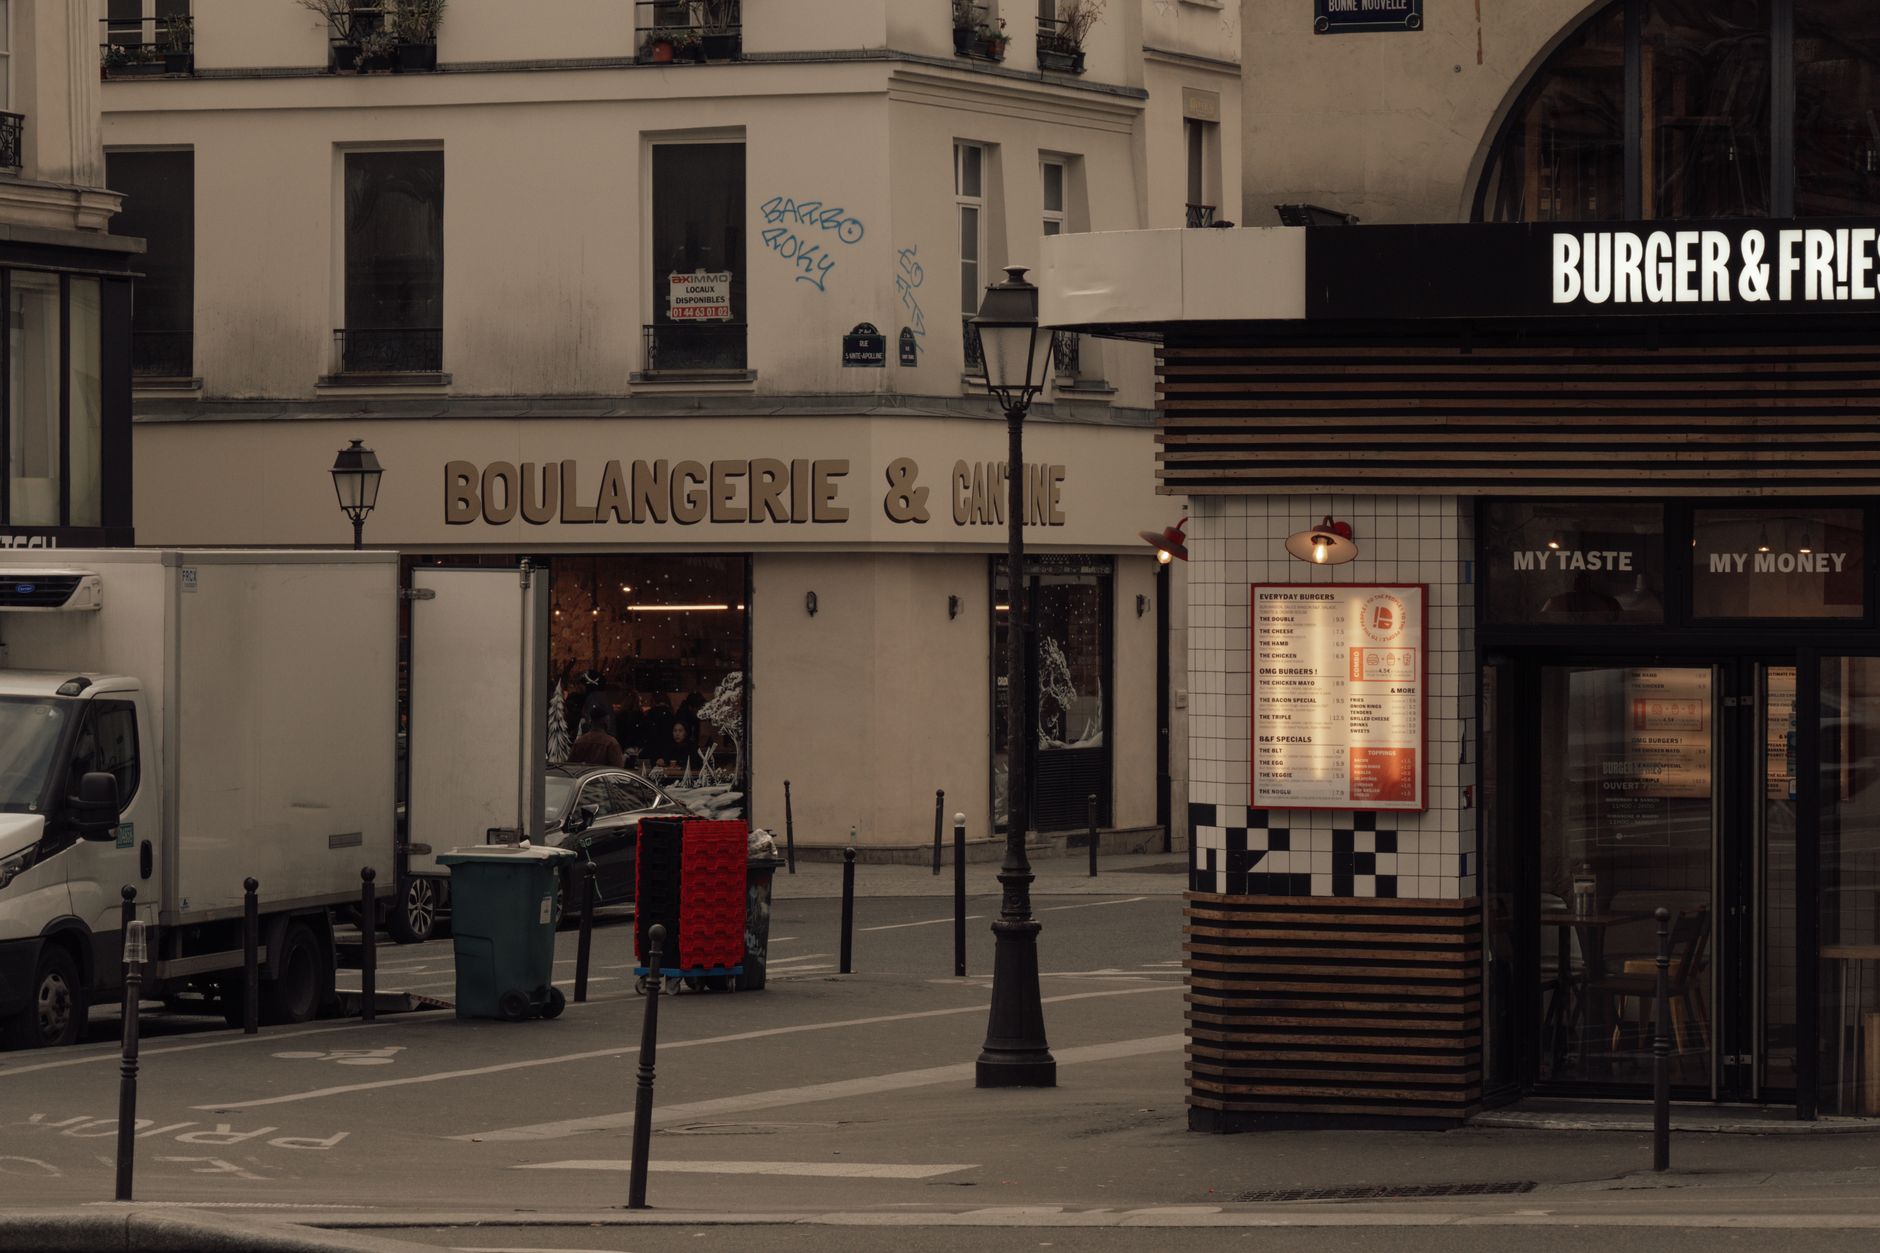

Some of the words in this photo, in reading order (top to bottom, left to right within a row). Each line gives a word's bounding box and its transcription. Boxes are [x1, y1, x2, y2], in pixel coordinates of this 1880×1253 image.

[1328, 0, 1358, 12] BONNE
[1361, 0, 1408, 11] NOUVELLE
[1552, 231, 1731, 304] BURGER
[1738, 229, 1771, 302] &
[686, 286, 715, 294] LOCAUX
[676, 296, 726, 304] DISPONIBLES
[673, 308, 683, 317] 01
[684, 308, 694, 317] 44
[695, 307, 705, 317] 63
[707, 307, 717, 316] 01
[718, 307, 728, 316] 02
[444, 458, 850, 526] BOULANGERIE
[883, 457, 931, 523] &
[1513, 551, 1550, 571] MY
[1555, 551, 1633, 571] TASTE
[1710, 554, 1747, 573] MY
[1754, 554, 1846, 573] MONEY
[1603, 782, 1640, 790] OUVERT
